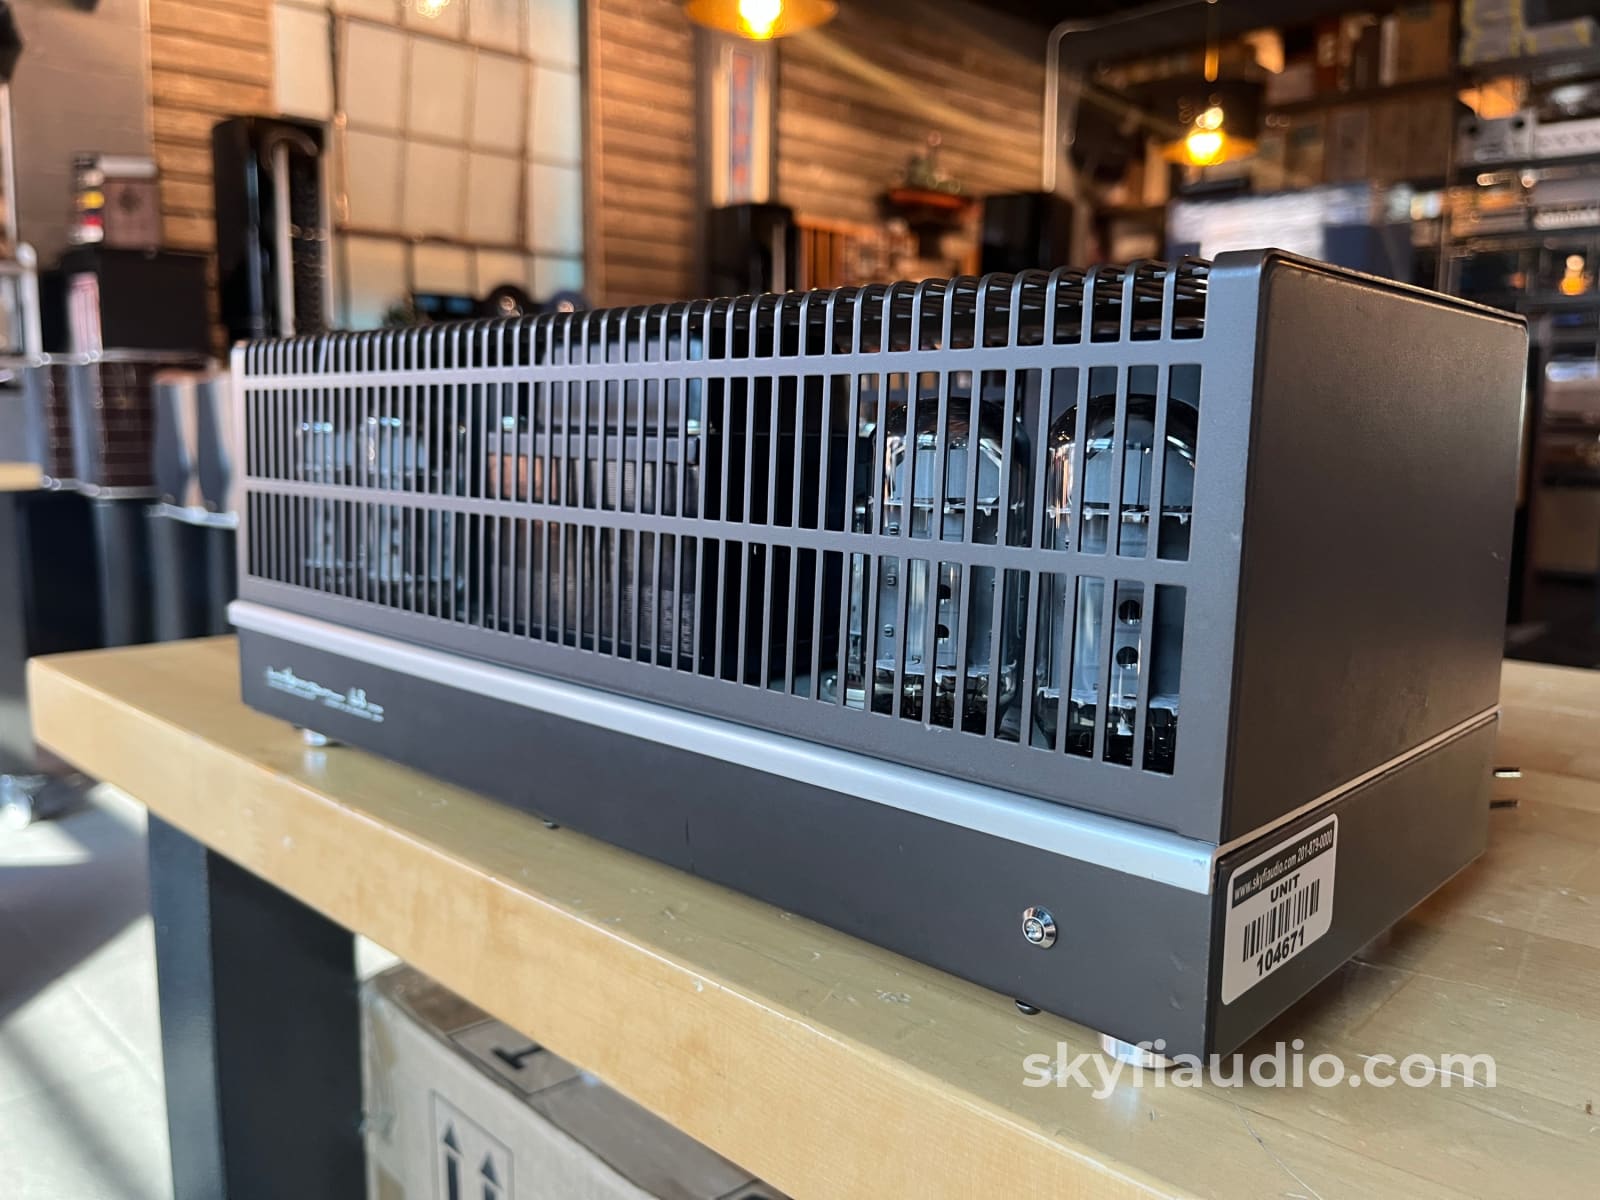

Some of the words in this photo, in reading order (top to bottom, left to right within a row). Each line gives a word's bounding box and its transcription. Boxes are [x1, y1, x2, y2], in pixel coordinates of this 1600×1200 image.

[1234, 854, 1297, 901] www.skyfiaudio.com
[1270, 873, 1300, 903] UNIT
[1256, 926, 1304, 976] 104671
